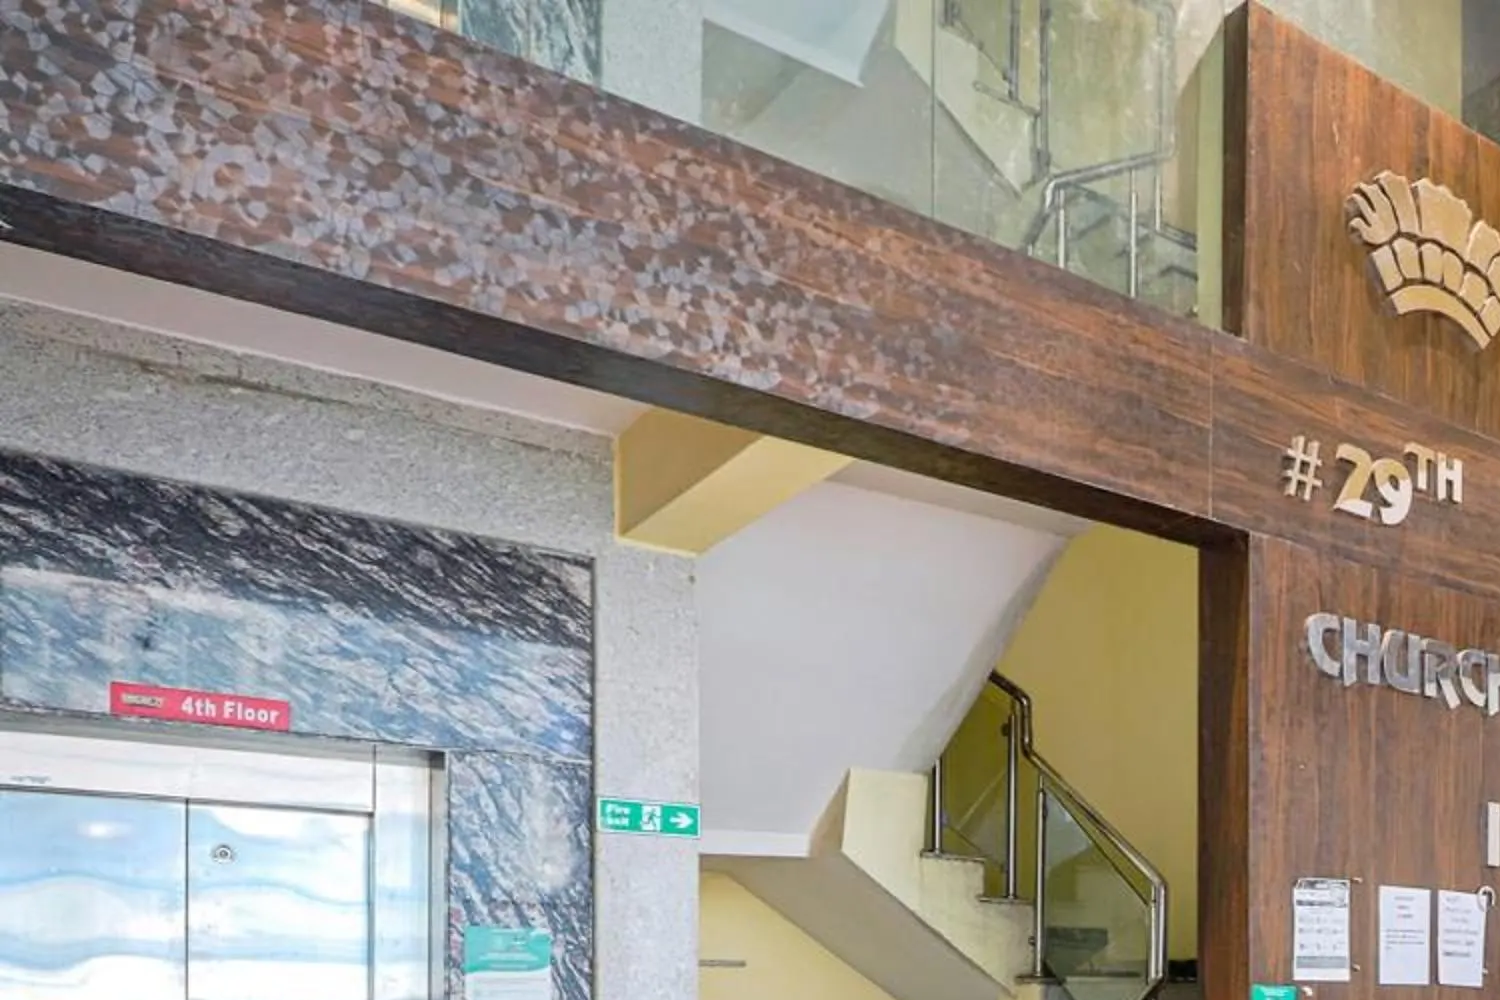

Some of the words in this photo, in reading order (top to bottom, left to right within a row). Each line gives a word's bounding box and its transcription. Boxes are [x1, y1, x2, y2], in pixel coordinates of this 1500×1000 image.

[1283, 435, 1323, 501] #
[181, 697, 217, 718] 4th
[223, 701, 280, 724] Floor
